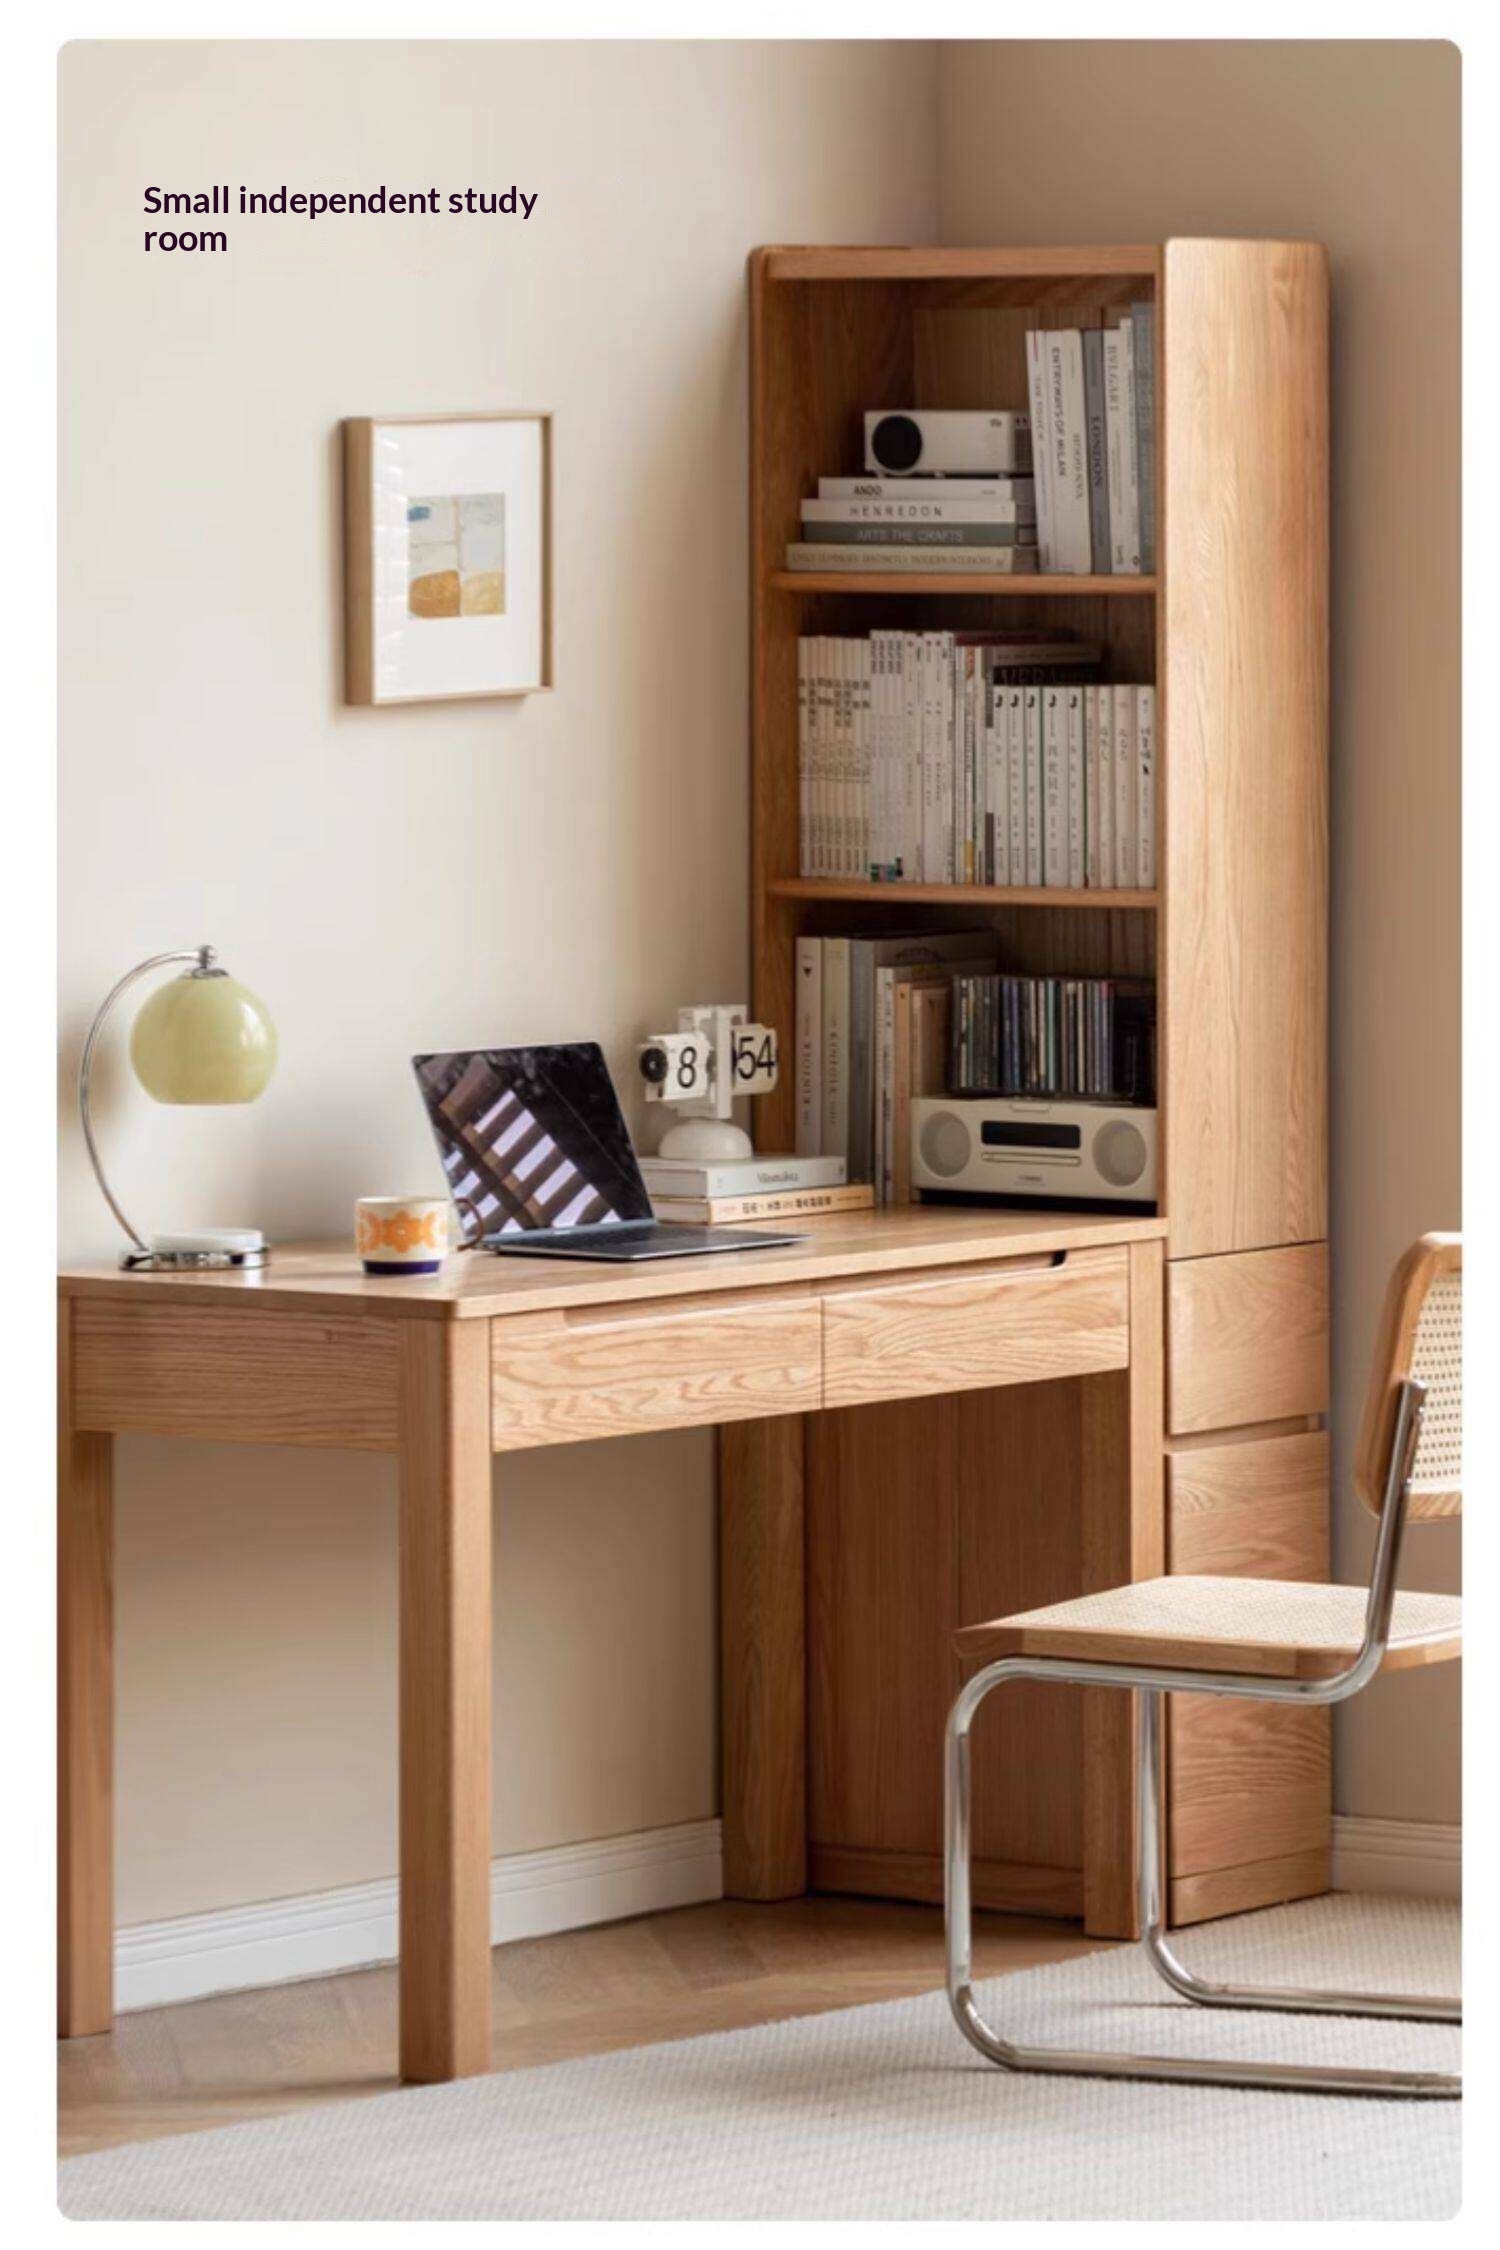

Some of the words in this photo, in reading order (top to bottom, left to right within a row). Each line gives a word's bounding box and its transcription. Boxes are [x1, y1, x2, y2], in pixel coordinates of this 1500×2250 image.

[1090, 415, 1102, 488] LONDON
[849, 504, 944, 518] HENREDON
[676, 1045, 697, 1089] 8
[738, 1034, 776, 1080] 54
